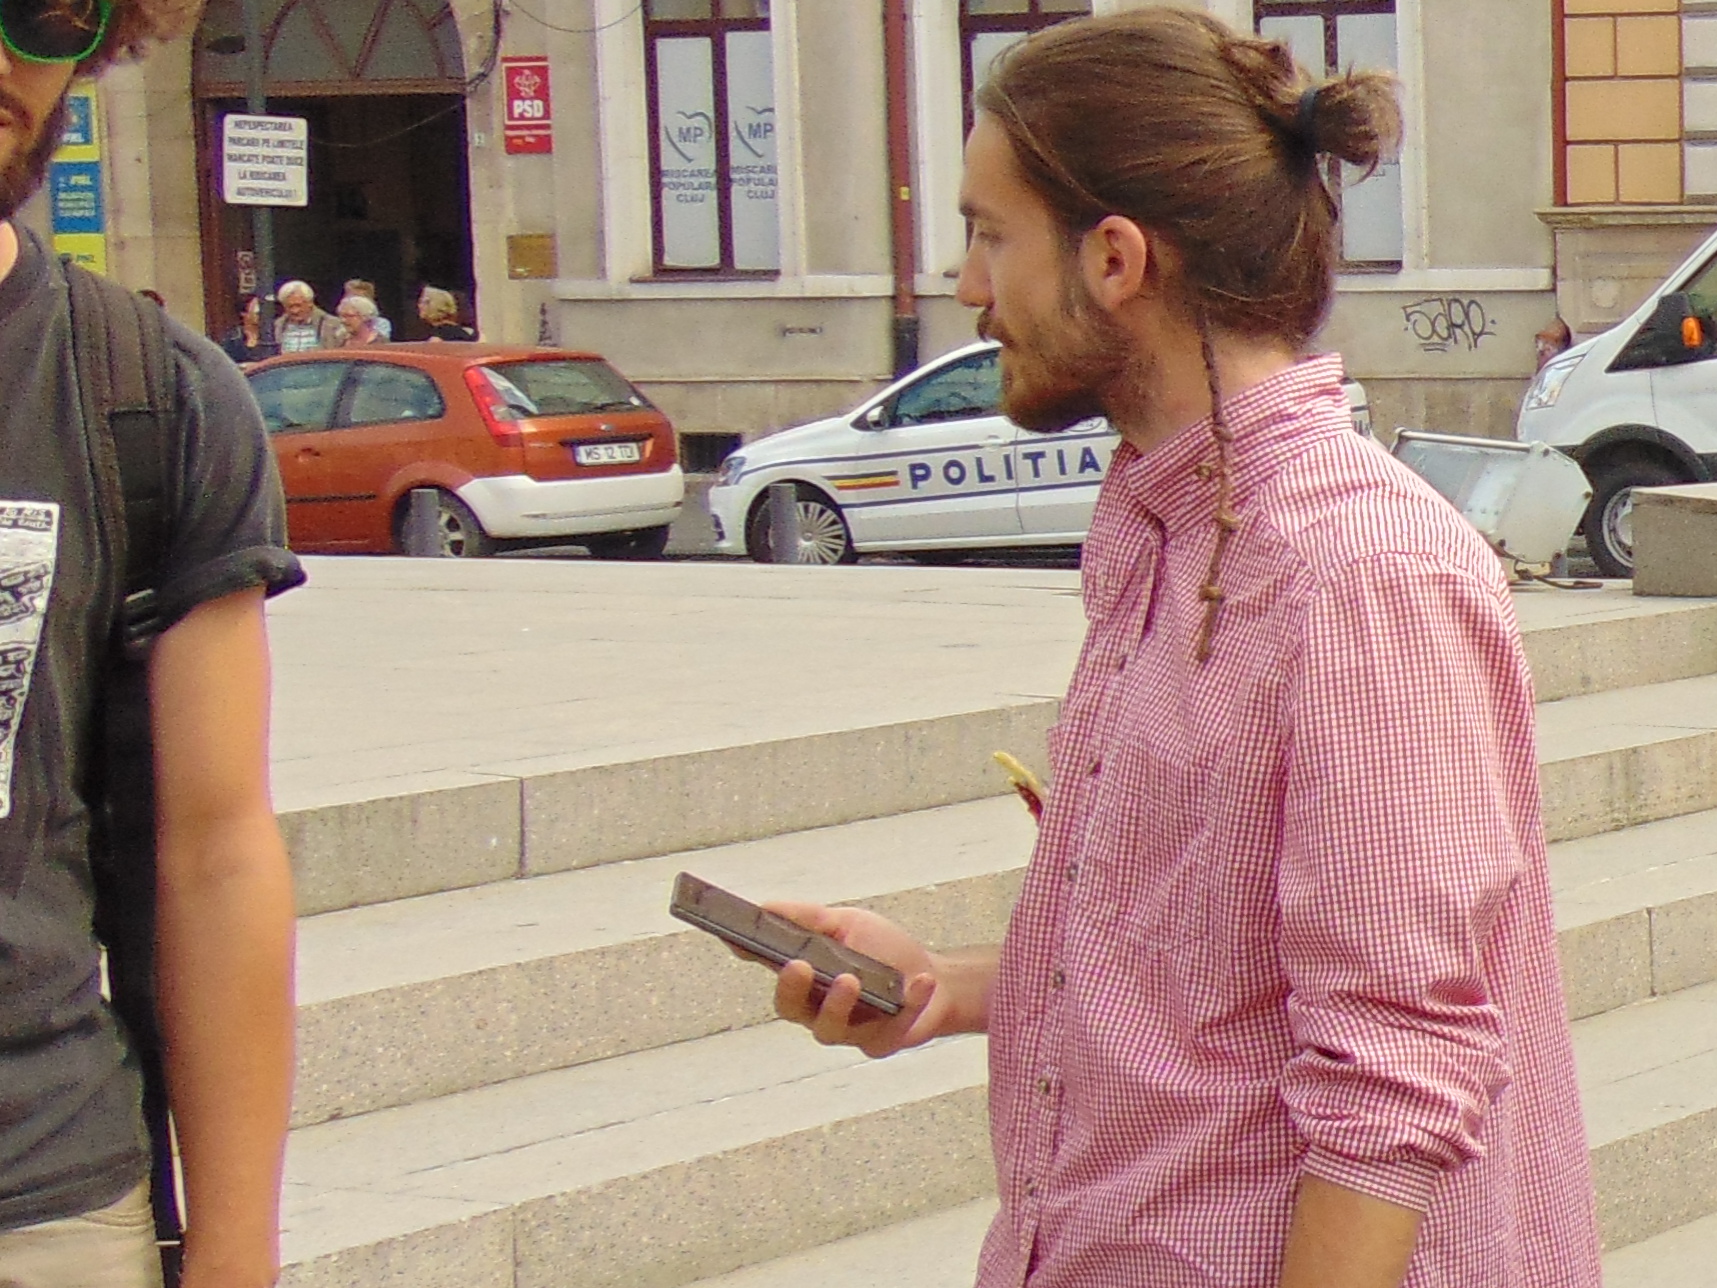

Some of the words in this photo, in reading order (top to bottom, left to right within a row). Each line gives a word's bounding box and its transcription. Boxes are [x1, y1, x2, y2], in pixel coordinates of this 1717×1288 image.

[513, 100, 544, 118] PSD
[678, 126, 704, 143] MP
[747, 122, 774, 139] MP
[908, 446, 1102, 490] POLITIA
